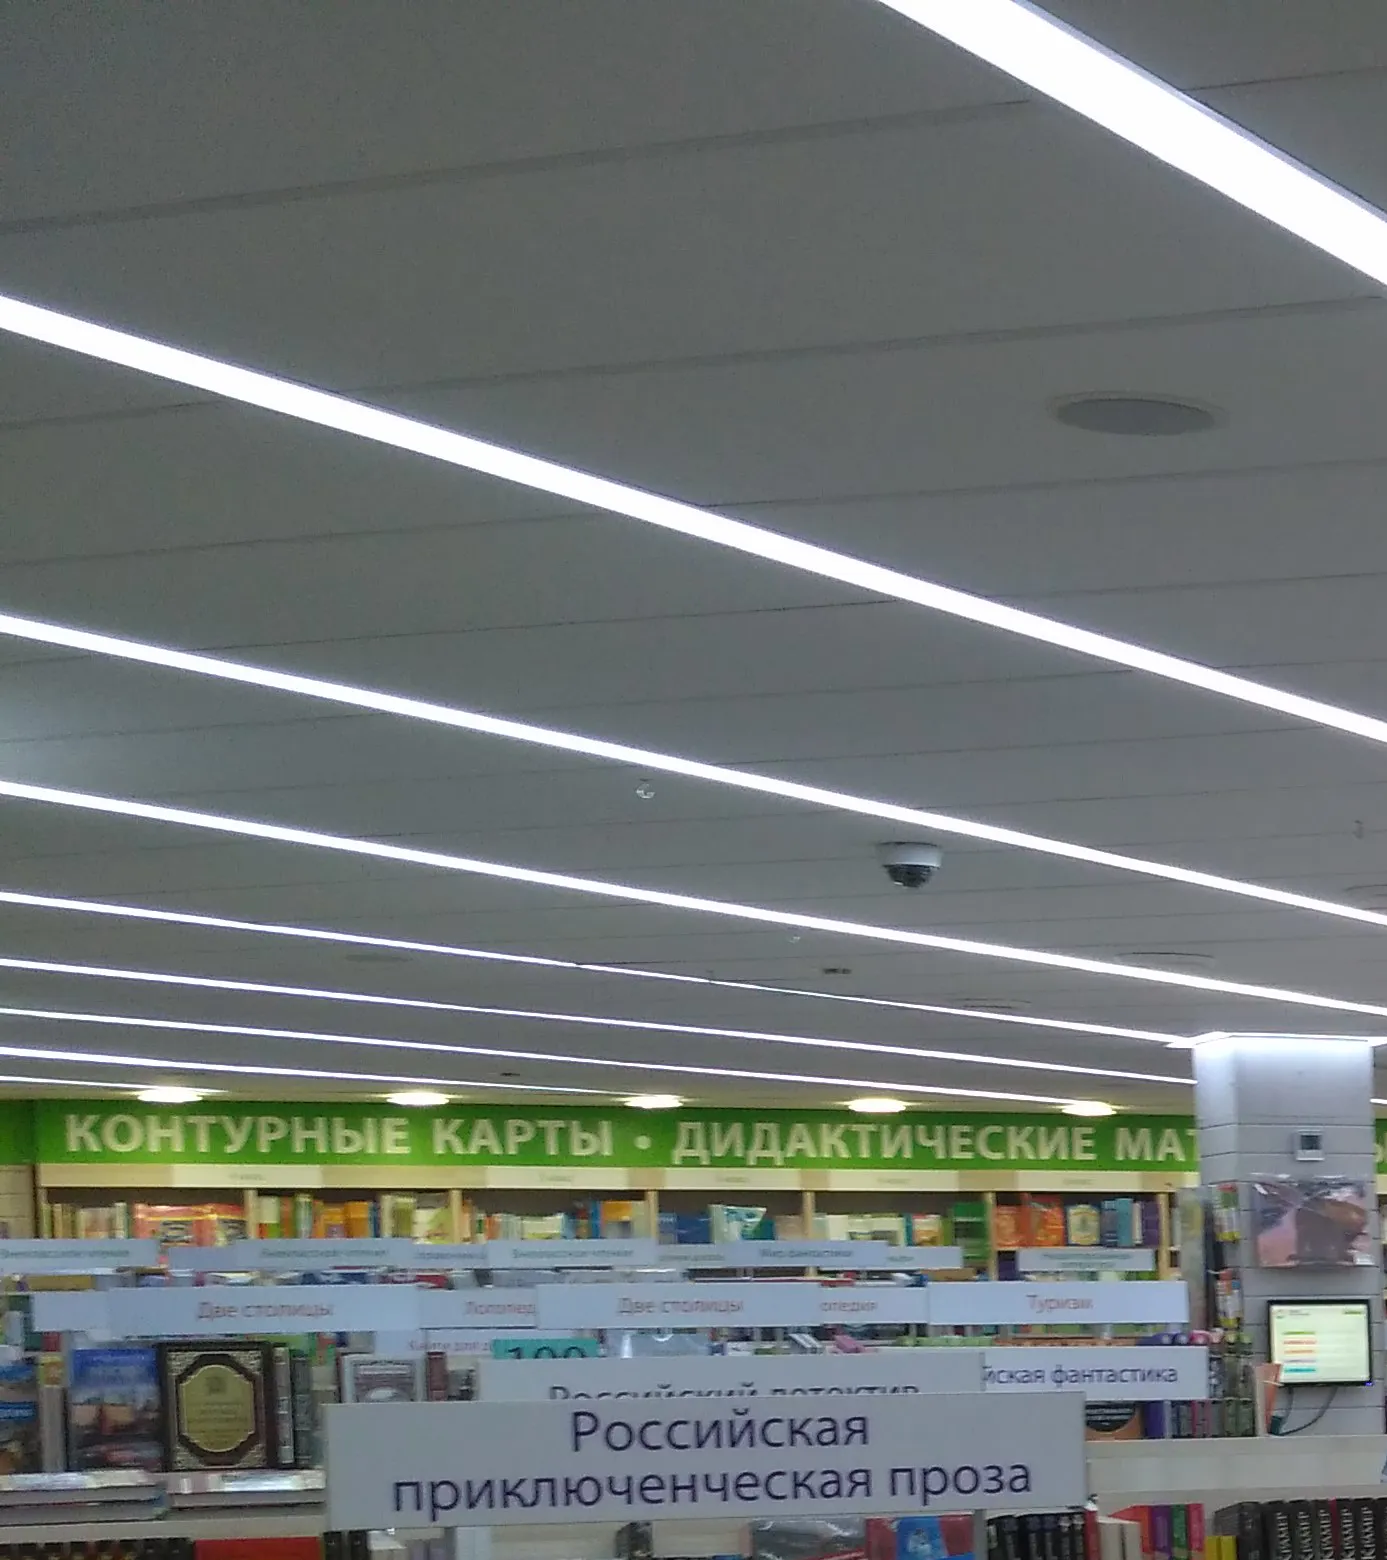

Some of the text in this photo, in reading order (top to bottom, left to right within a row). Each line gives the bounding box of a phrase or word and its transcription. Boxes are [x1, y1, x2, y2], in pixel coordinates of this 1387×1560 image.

[66, 1113, 410, 1155] КОНТУРНЫЕ
[433, 1117, 612, 1157] КАРТЫ
[671, 1120, 1098, 1167] ДИДАКТИЧЕСКИЕ
[198, 1302, 333, 1321] Две столицы
[617, 1296, 744, 1316] Две столицы
[1028, 1294, 1094, 1312] Туризм
[1050, 1362, 1179, 1388] фантастика
[570, 1408, 869, 1453] Российская
[393, 1463, 1032, 1522] приключенческая проза
